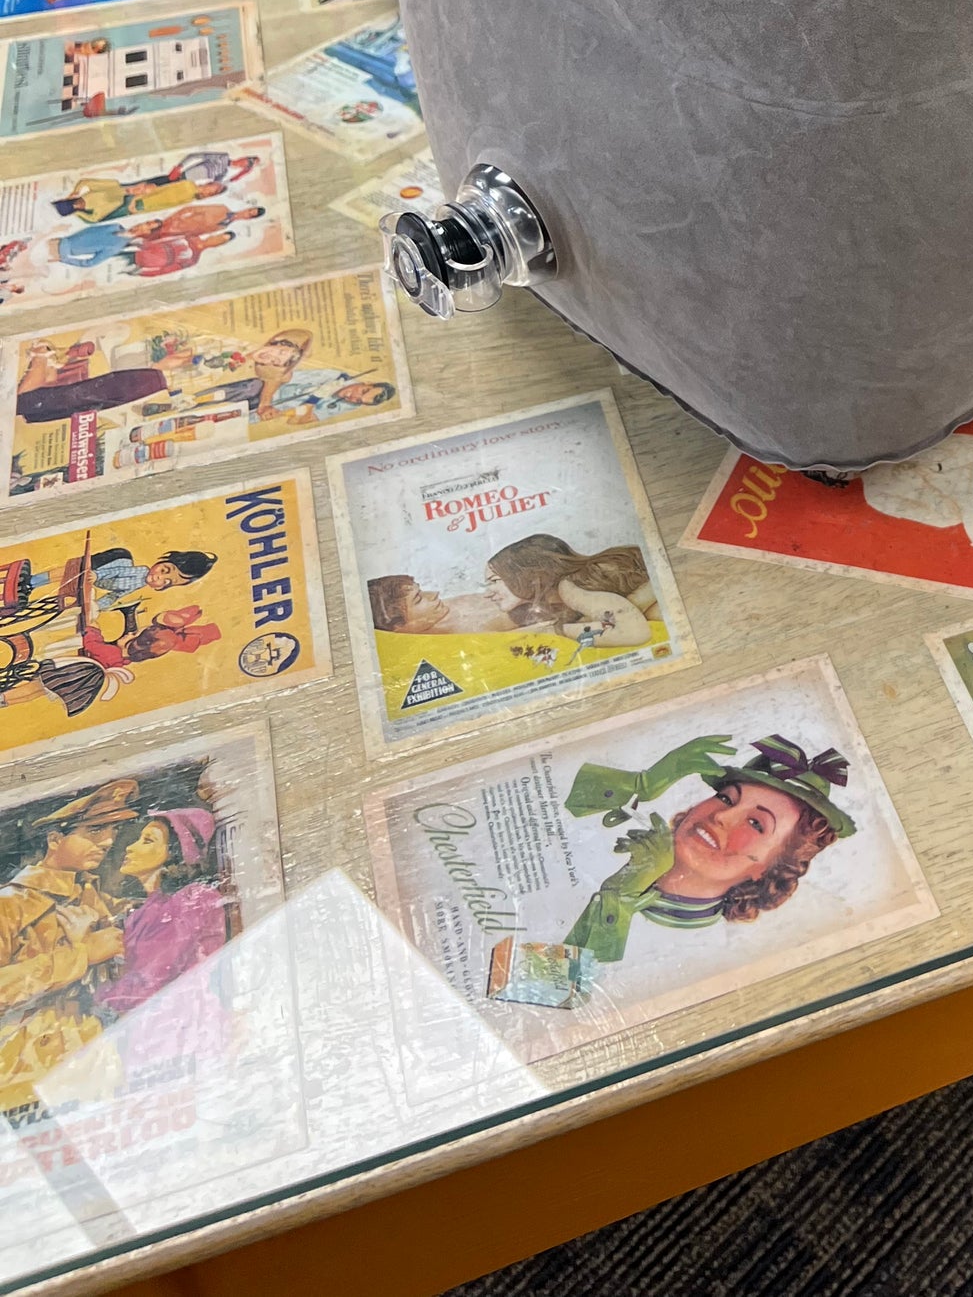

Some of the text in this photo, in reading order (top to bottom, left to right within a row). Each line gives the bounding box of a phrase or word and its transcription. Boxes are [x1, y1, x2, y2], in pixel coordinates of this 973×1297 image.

[76, 413, 95, 480] Budweiser
[368, 463, 394, 476] No
[398, 440, 479, 466] ordinary
[483, 432, 517, 446] love
[424, 485, 518, 521] ROMEO
[447, 491, 551, 533] & JULIET
[225, 485, 294, 629] KÖHLER
[407, 684, 455, 704] EXHIBITION
[411, 678, 448, 695] GENERAL
[415, 672, 437, 682] FOR
[412, 803, 528, 936] Chesterfield
[564, 851, 574, 865] New
[434, 902, 447, 932] MORE
